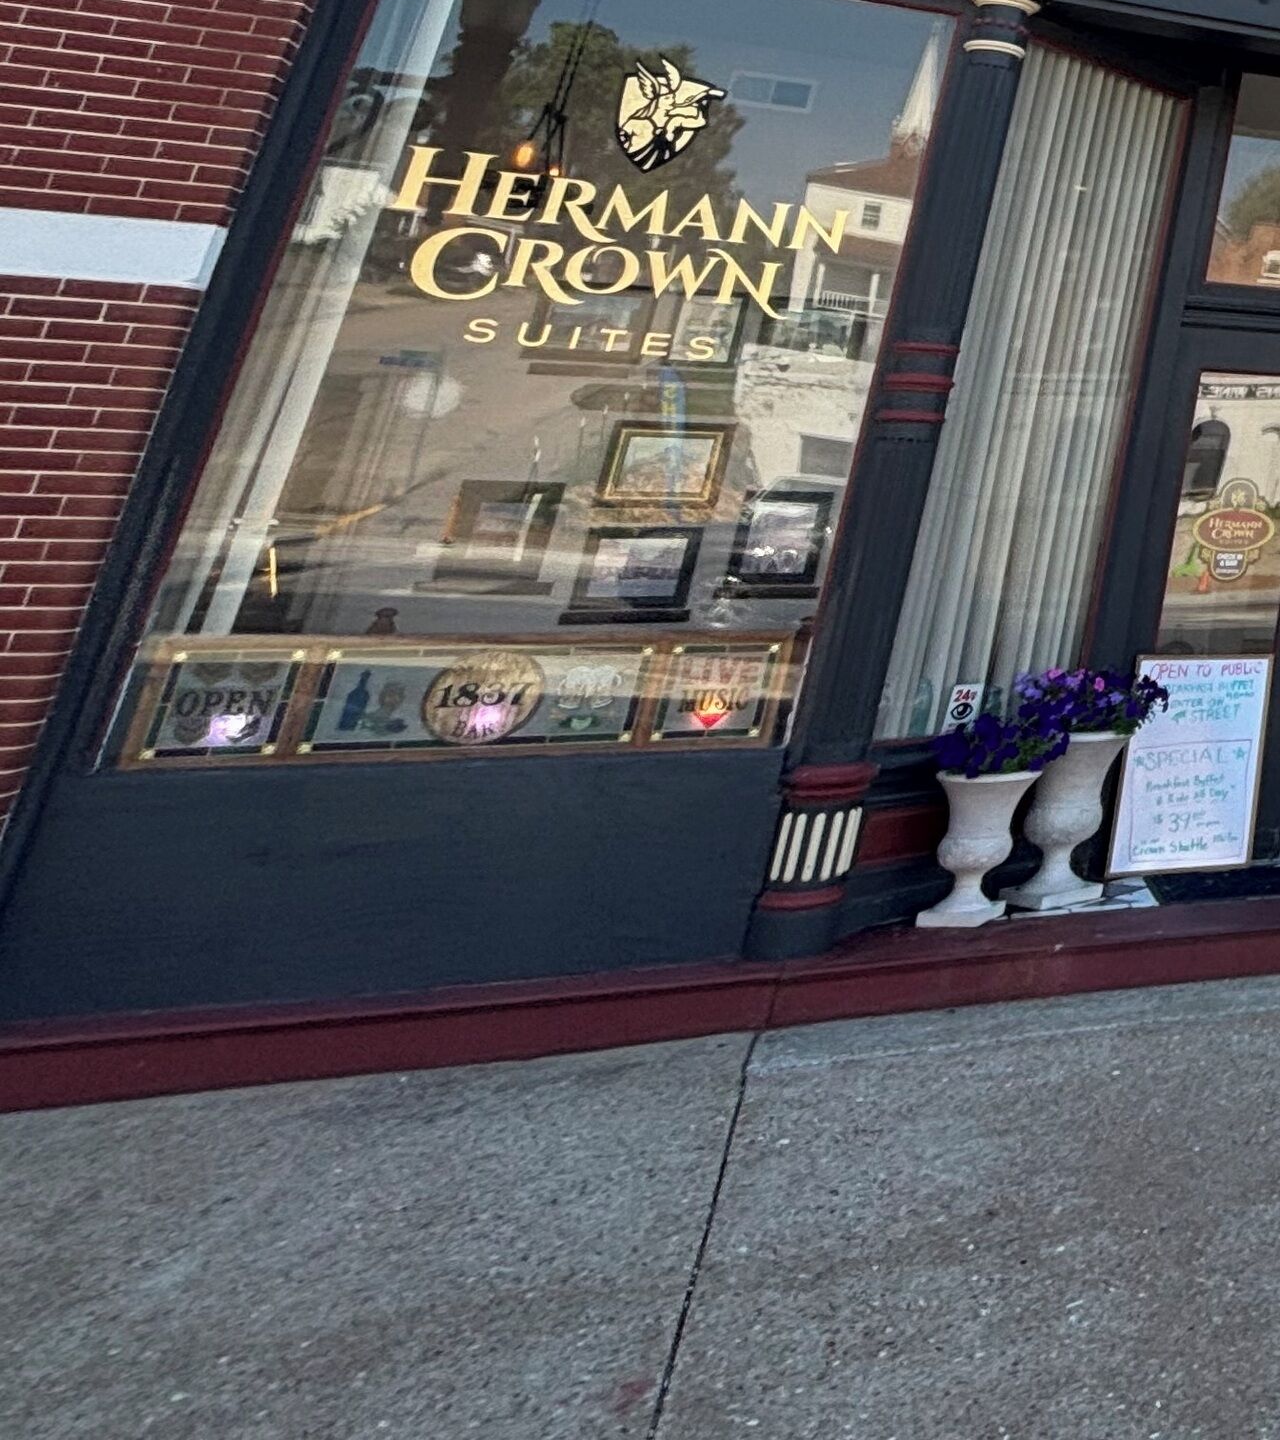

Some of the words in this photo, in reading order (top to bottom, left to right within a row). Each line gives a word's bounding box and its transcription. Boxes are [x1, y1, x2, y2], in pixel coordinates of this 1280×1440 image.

[391, 145, 850, 254] HERMANN
[410, 227, 788, 320] CROWN
[464, 318, 716, 360] SUITES
[1209, 518, 1263, 530] HERMANN
[1211, 528, 1255, 539] CROWN
[681, 656, 763, 684] LIVE
[1150, 663, 1189, 680] OPEN
[1197, 664, 1212, 677] TO
[1221, 662, 1263, 676] PUBLIC
[175, 688, 281, 717] OPEN
[435, 682, 536, 708] 1837
[678, 689, 748, 713] MUSIC
[1170, 699, 1204, 709] ENTER
[1210, 698, 1225, 707] ON
[1190, 703, 1240, 722] STREET
[453, 720, 497, 739] BAR
[1145, 746, 1227, 771] SPECIAL
